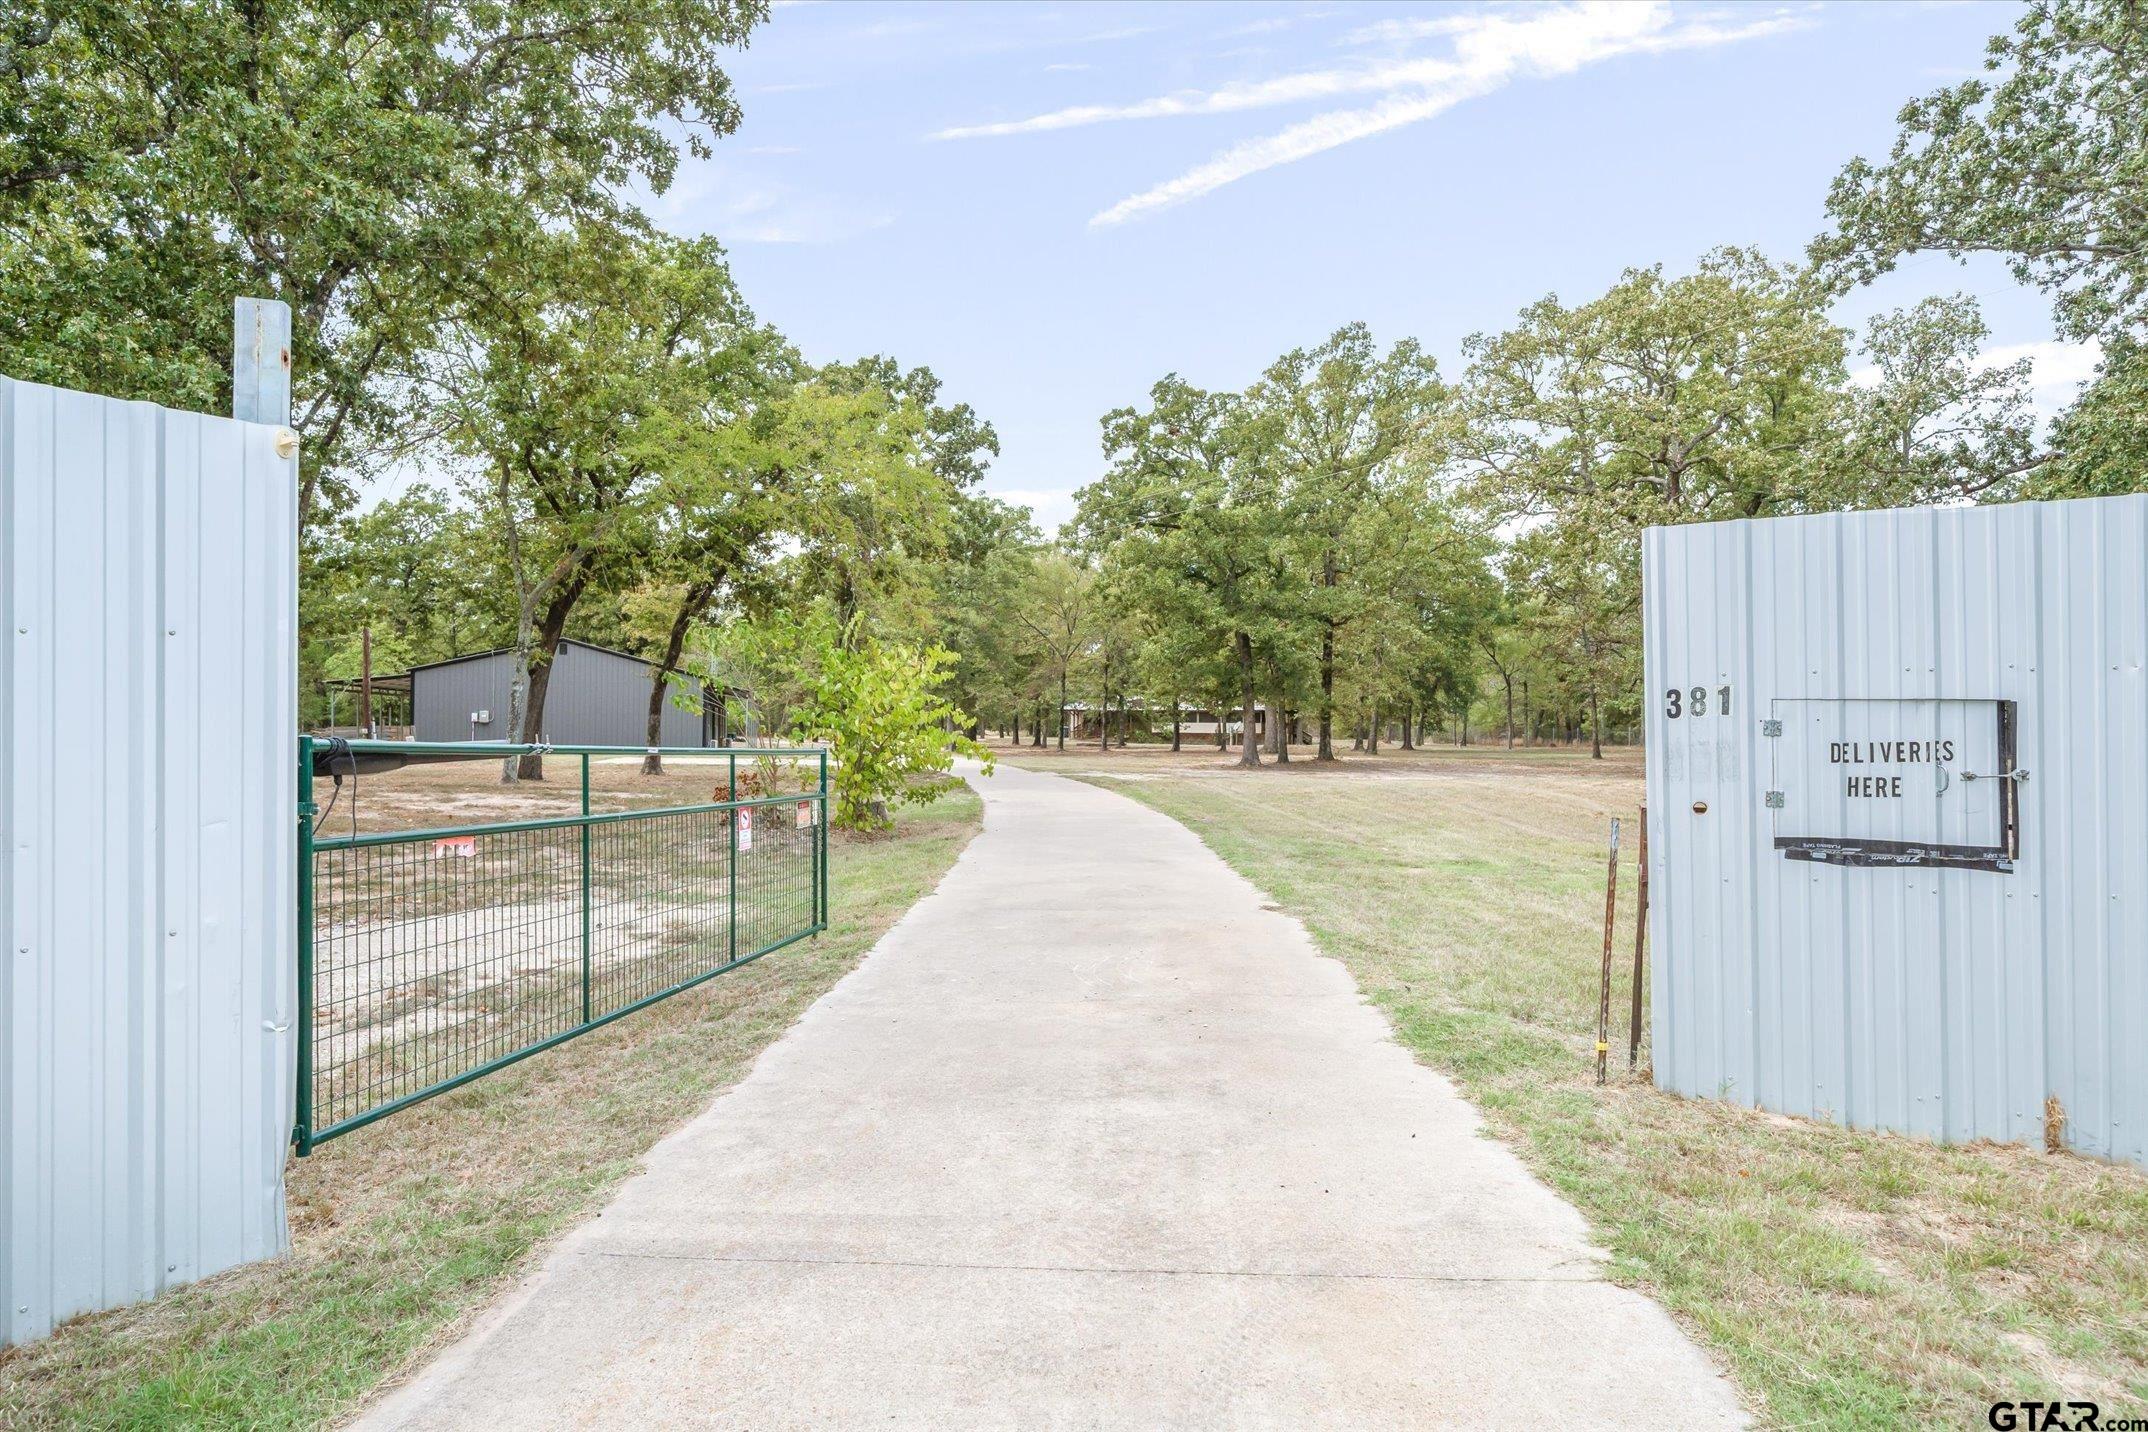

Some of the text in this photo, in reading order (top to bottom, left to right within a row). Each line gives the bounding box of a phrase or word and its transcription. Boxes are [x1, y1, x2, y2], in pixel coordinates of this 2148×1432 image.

[1666, 686, 1731, 719] 381
[1830, 741, 1954, 763] DELIVERIES
[1847, 776, 1902, 798] HERE
